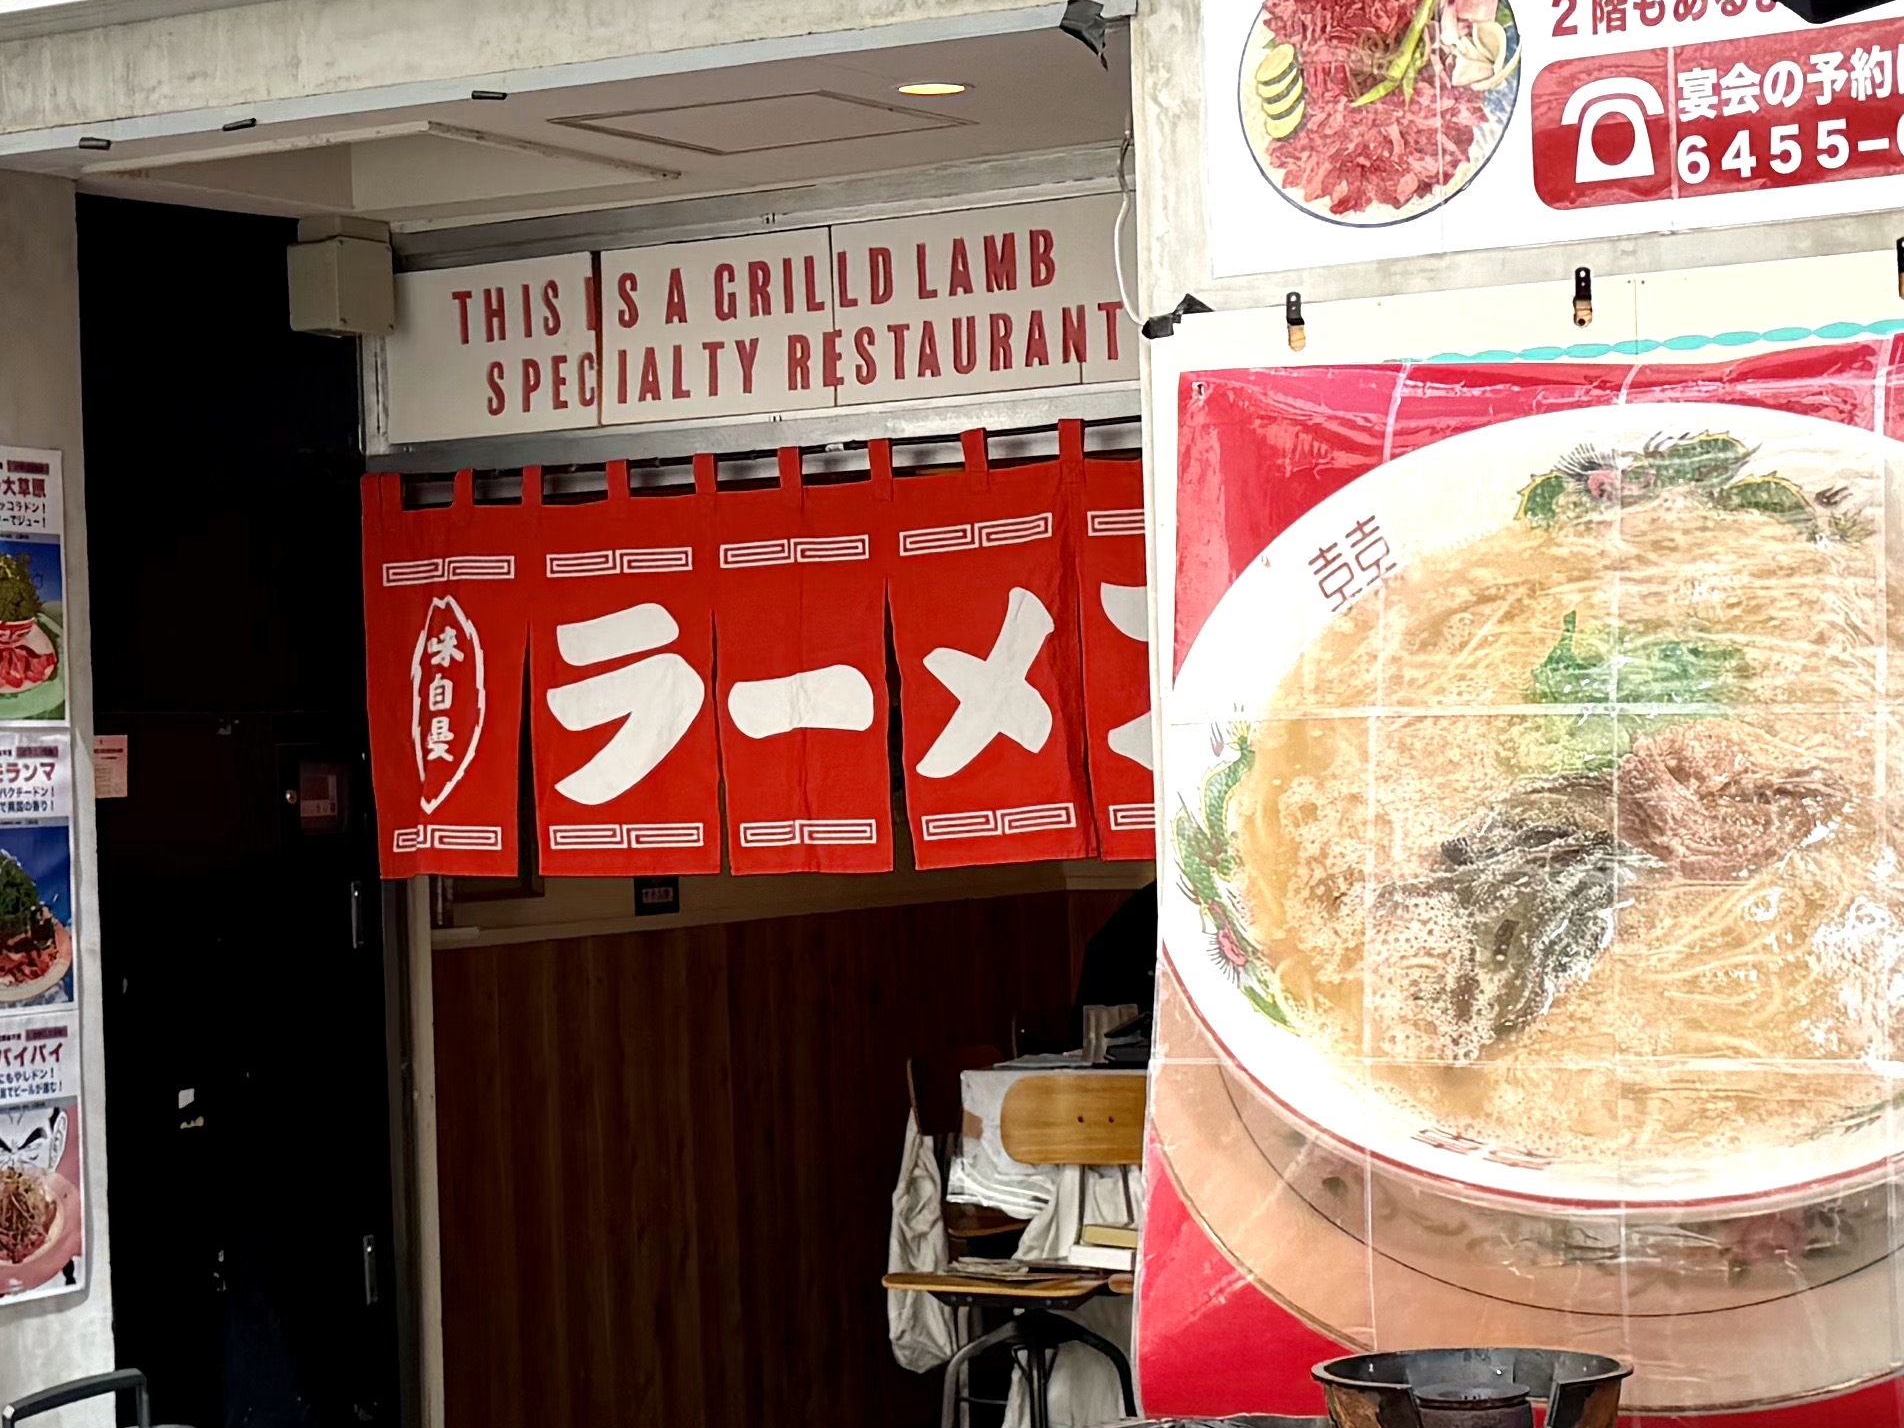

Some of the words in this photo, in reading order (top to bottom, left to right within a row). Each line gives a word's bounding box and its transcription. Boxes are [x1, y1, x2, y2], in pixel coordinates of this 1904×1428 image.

[452, 283, 561, 346] THIS
[665, 267, 688, 325] A
[714, 244, 894, 320] GRILLD
[916, 228, 1057, 300] LAMB
[486, 337, 760, 418] SPECIALTY
[787, 301, 1125, 392] RESTAURANT
